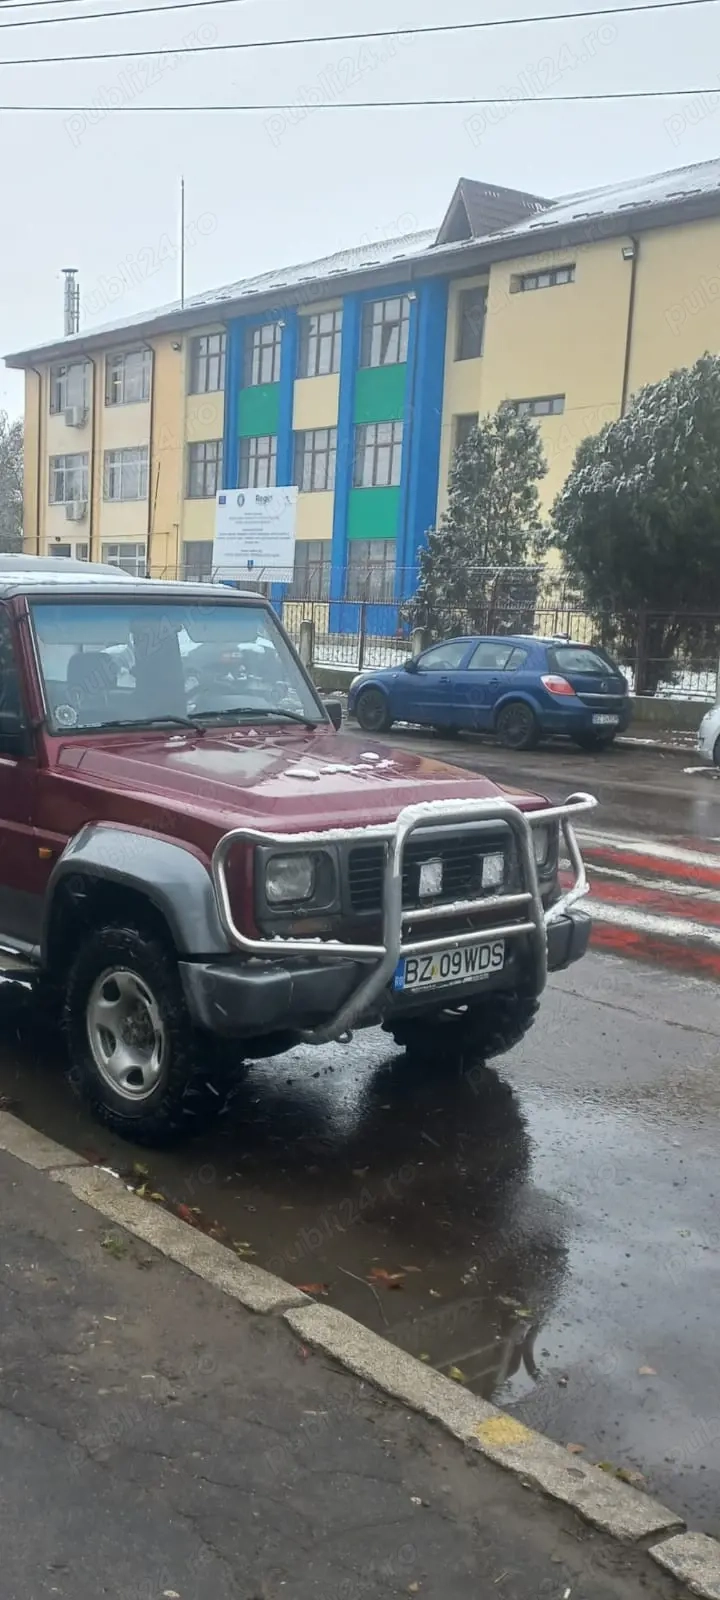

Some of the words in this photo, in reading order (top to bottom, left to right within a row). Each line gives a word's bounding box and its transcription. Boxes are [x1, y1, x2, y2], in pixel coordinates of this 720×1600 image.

[405, 956, 433, 984] BZ
[440, 952, 461, 978] 09
[464, 943, 503, 973] WDS
